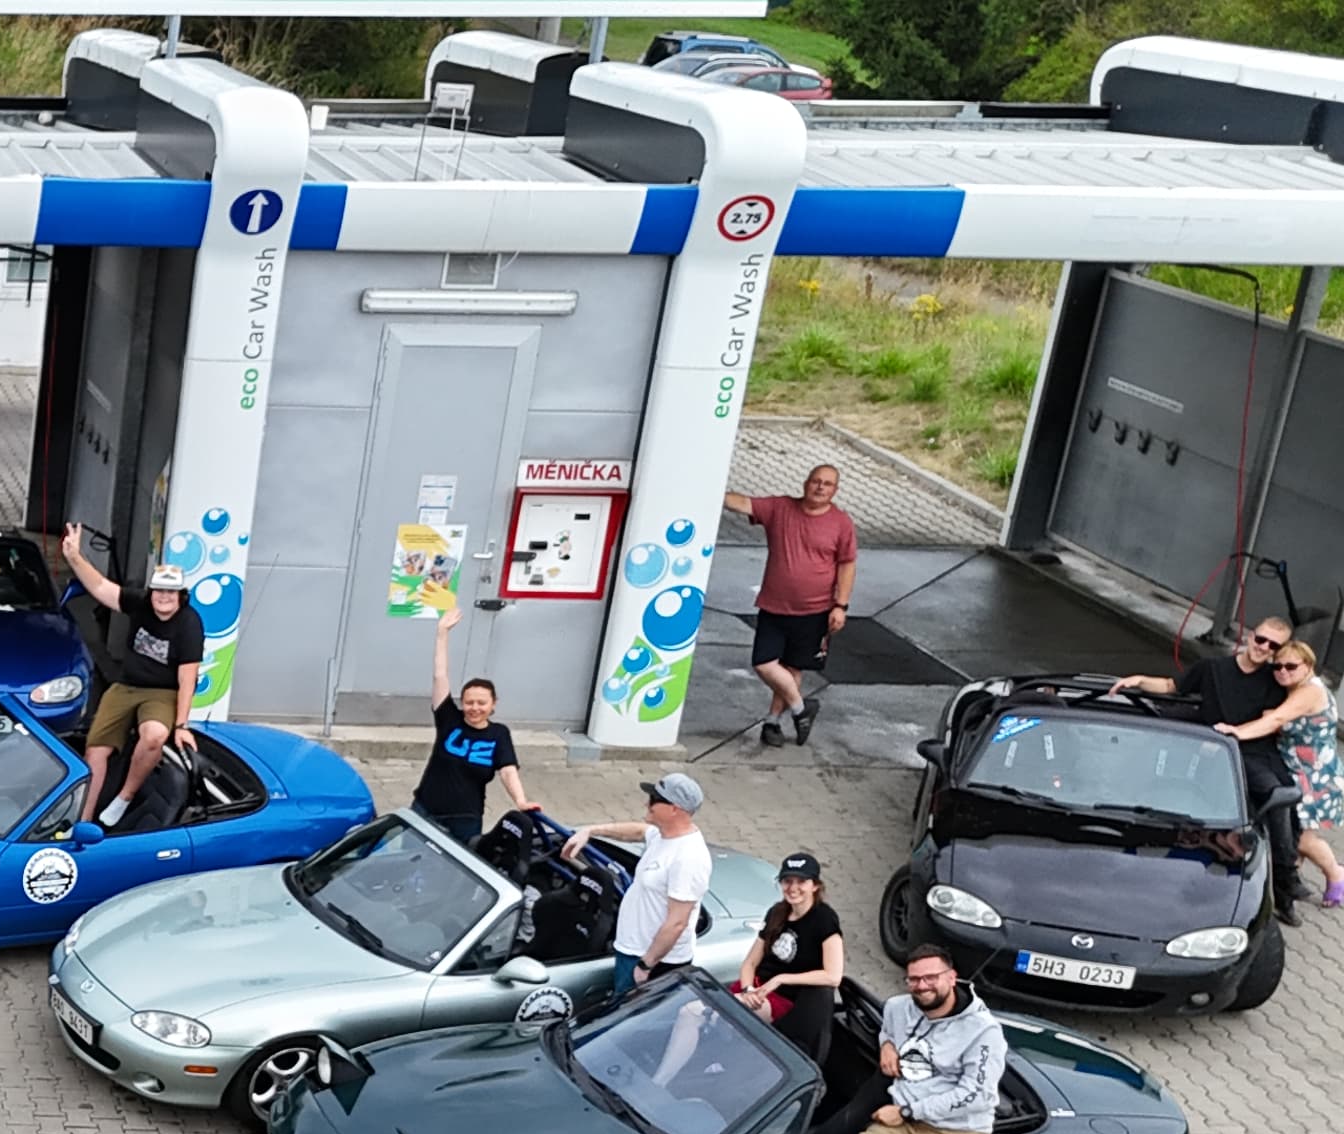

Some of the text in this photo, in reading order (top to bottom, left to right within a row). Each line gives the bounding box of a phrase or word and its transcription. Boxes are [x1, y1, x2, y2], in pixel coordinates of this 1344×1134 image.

[730, 212, 762, 225] 2.75
[240, 248, 278, 410] eco Car Wash
[714, 254, 764, 418] eco Car Wash
[525, 459, 623, 481] MĚNIČKA
[1032, 957, 1125, 985] 5H3 0233
